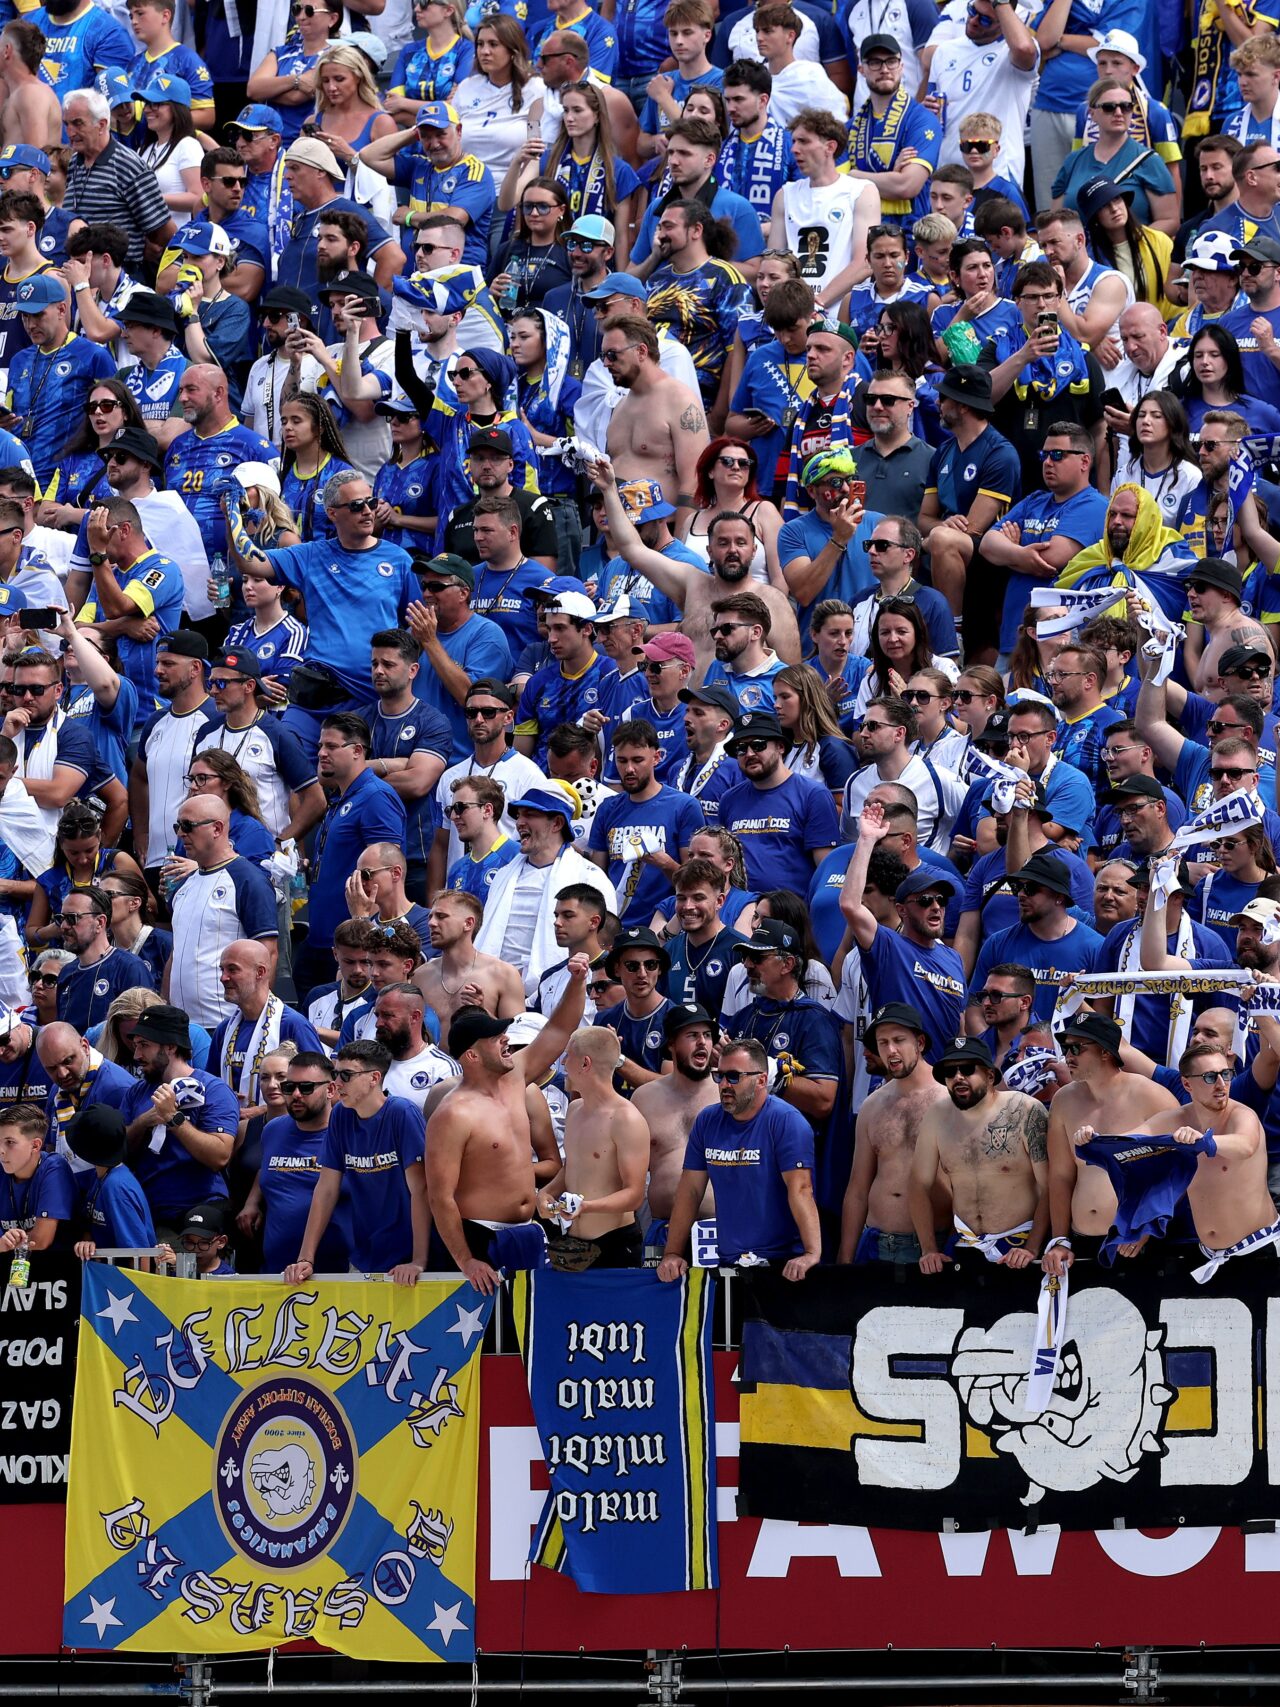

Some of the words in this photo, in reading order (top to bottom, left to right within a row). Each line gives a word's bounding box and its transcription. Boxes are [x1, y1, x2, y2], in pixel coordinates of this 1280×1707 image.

[962, 70, 973, 93] 6
[482, 111, 497, 128] 7
[801, 266, 818, 275] FIFA
[182, 470, 205, 492] 20
[731, 817, 791, 831] BHFANATICOS
[683, 976, 697, 1002] 5
[704, 1147, 761, 1162] BHFANATICOS
[256, 1387, 307, 1412] SUPPORT
[556, 1377, 656, 1420] malo
[264, 1428, 285, 1437] 2000
[286, 1429, 307, 1438] since
[305, 1394, 344, 1451] BOSNIAN
[555, 1490, 659, 1533] malo
[226, 1498, 339, 1560] BHFANATICOS
